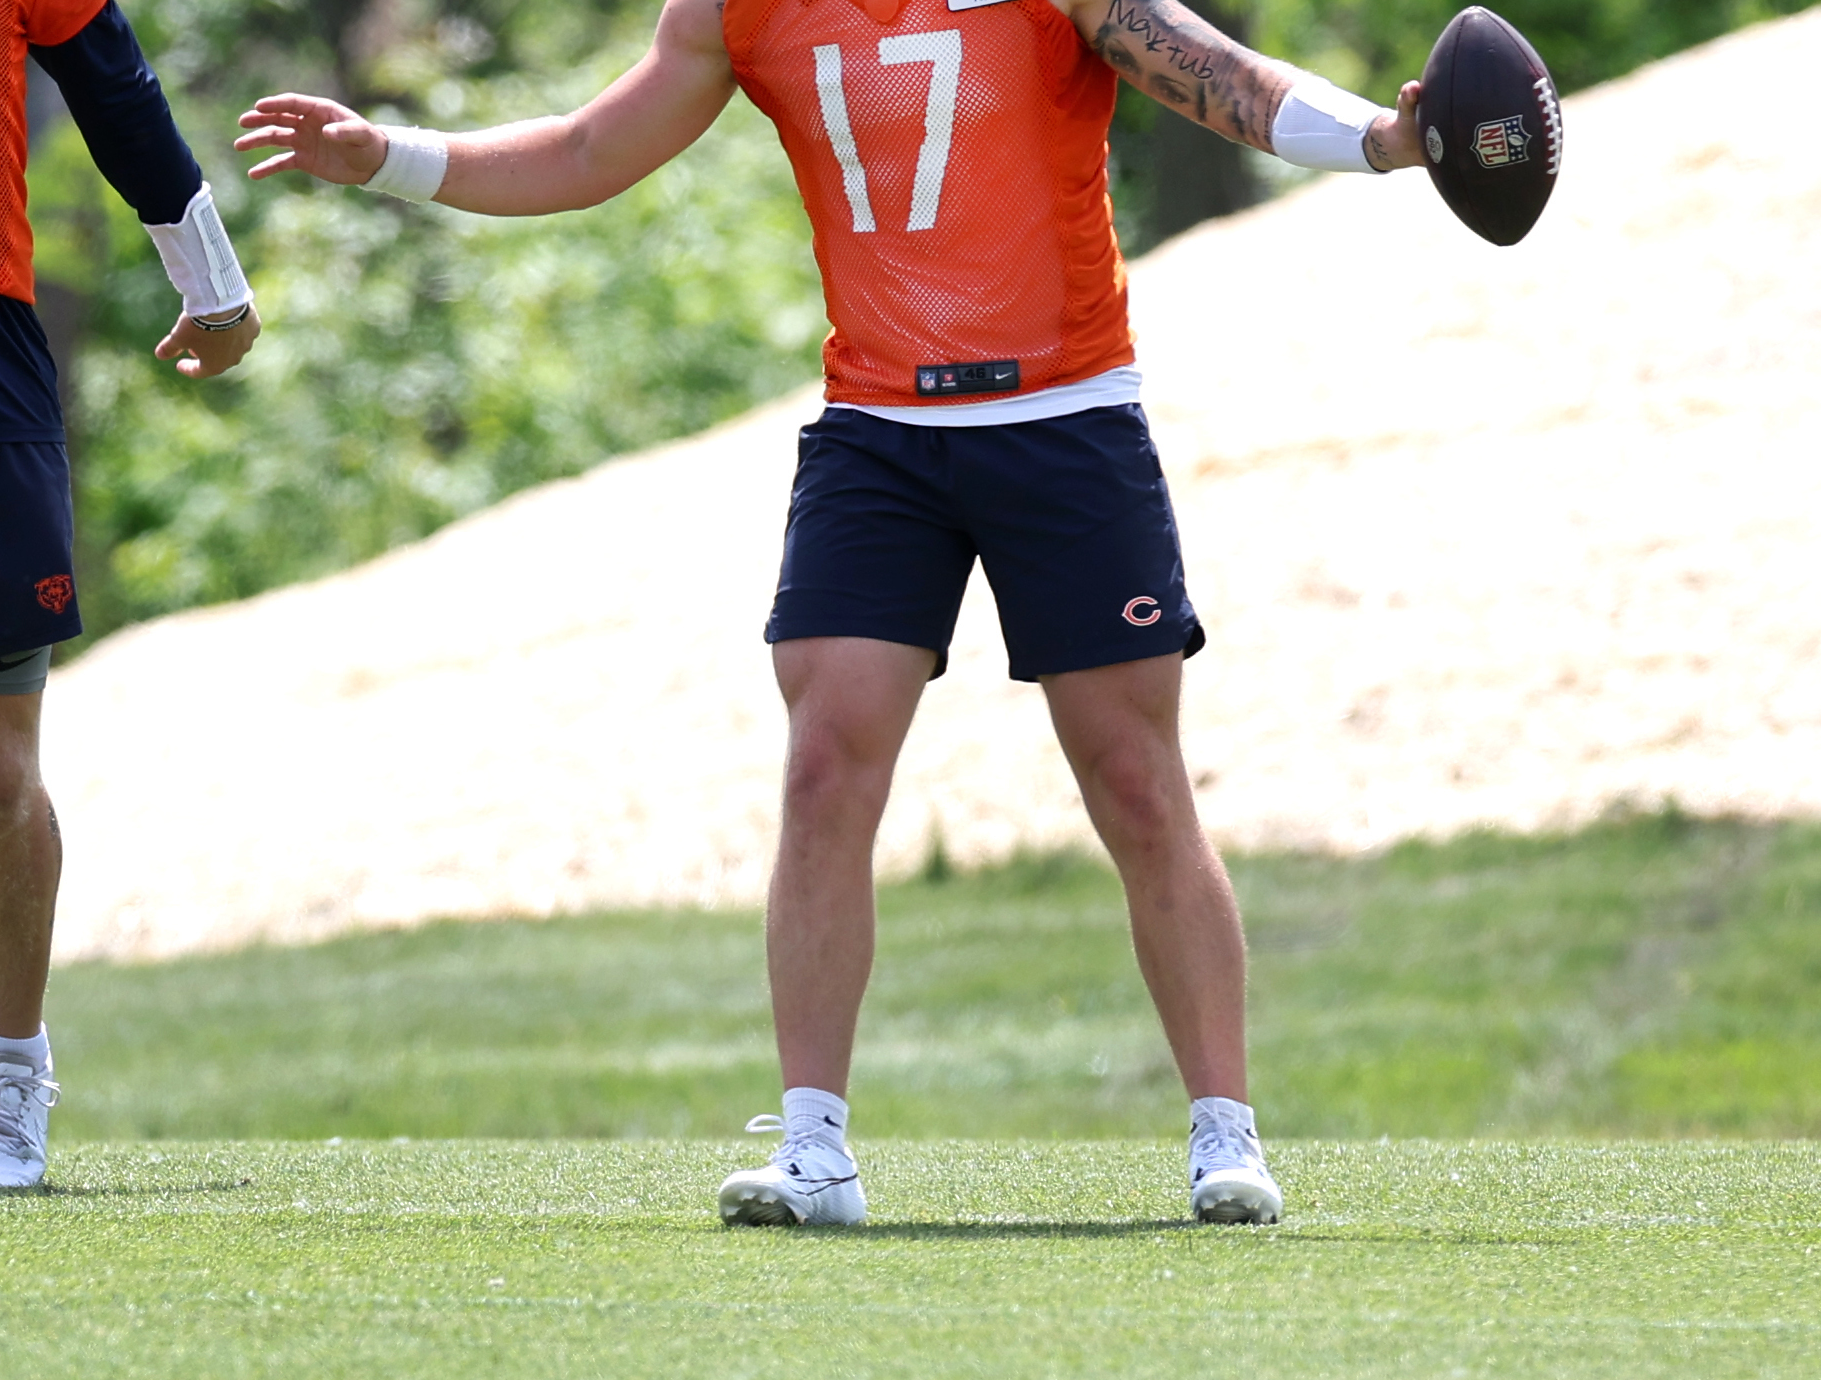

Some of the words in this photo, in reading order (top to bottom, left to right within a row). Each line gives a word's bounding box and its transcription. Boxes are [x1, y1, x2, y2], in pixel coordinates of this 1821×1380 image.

[813, 29, 963, 233] 17
[1481, 125, 1508, 164] NFL
[965, 367, 986, 379] 46
[1121, 596, 1161, 626] C
